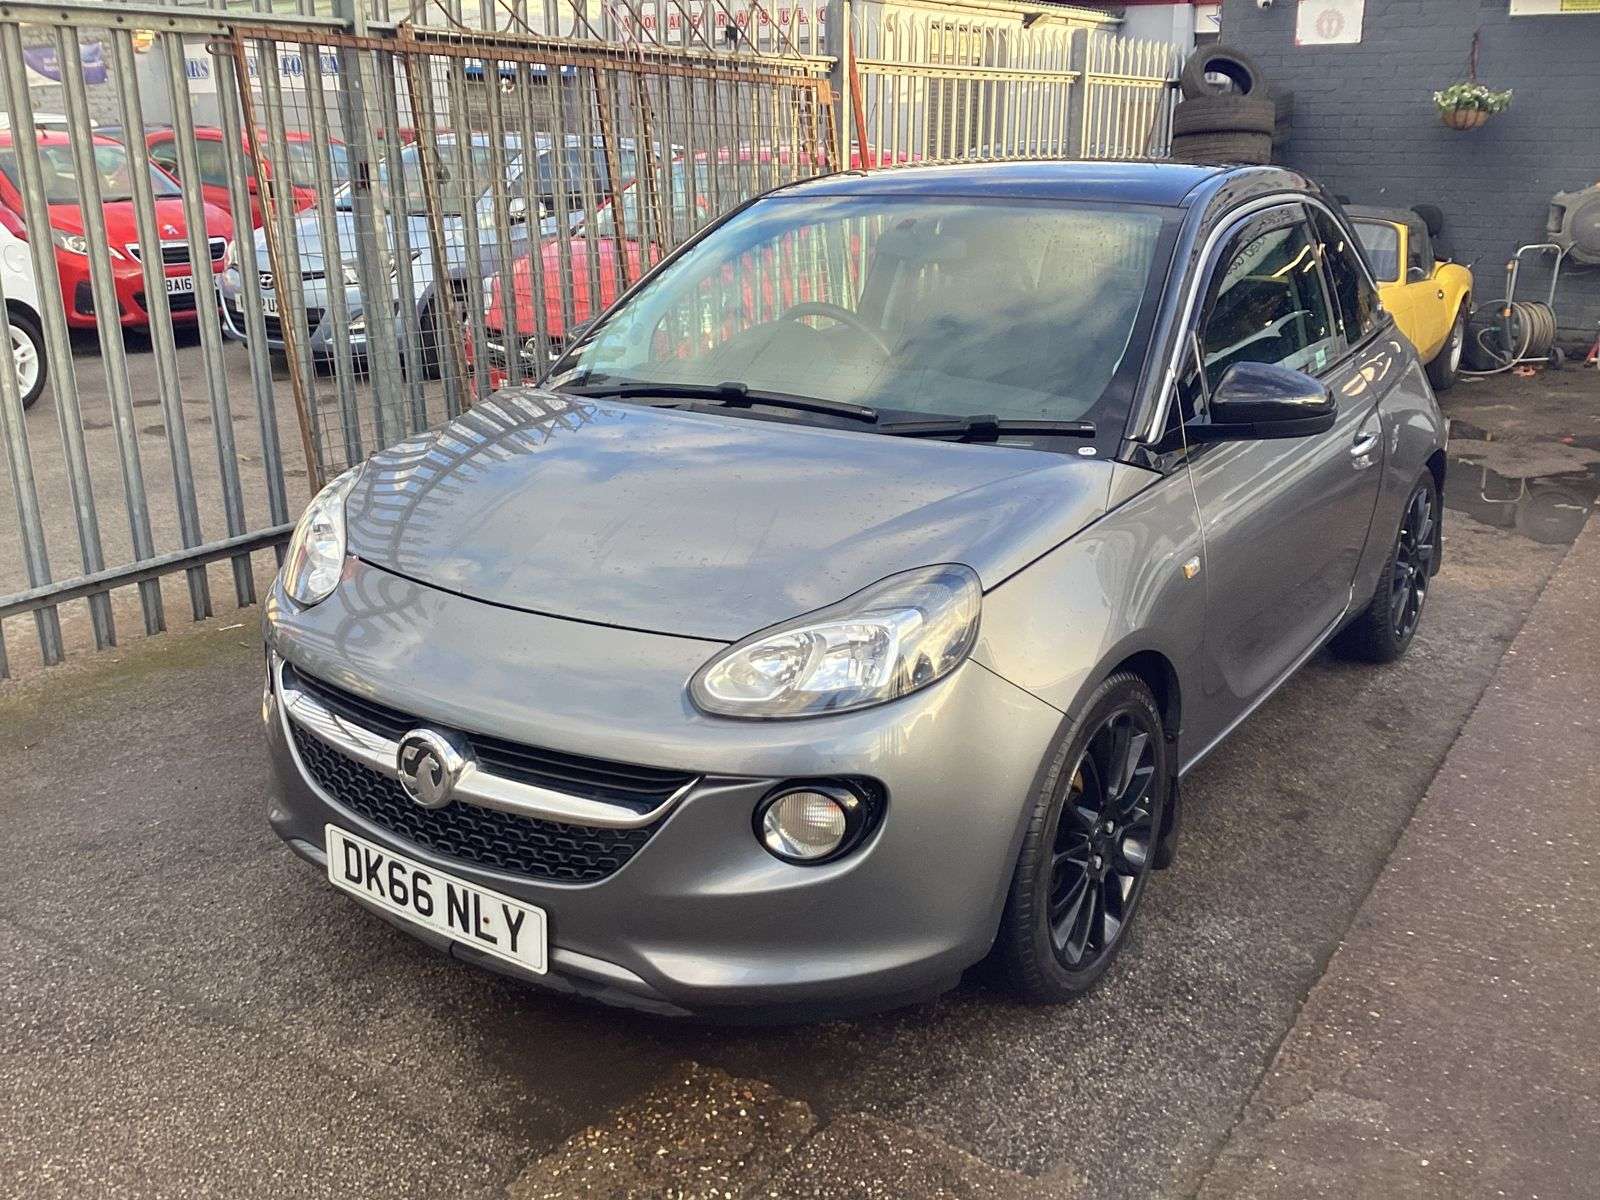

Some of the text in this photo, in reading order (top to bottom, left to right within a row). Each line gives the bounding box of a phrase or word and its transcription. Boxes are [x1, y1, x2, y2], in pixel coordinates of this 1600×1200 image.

[166, 277, 193, 292] BA16
[342, 838, 526, 953] DK66 NLY
